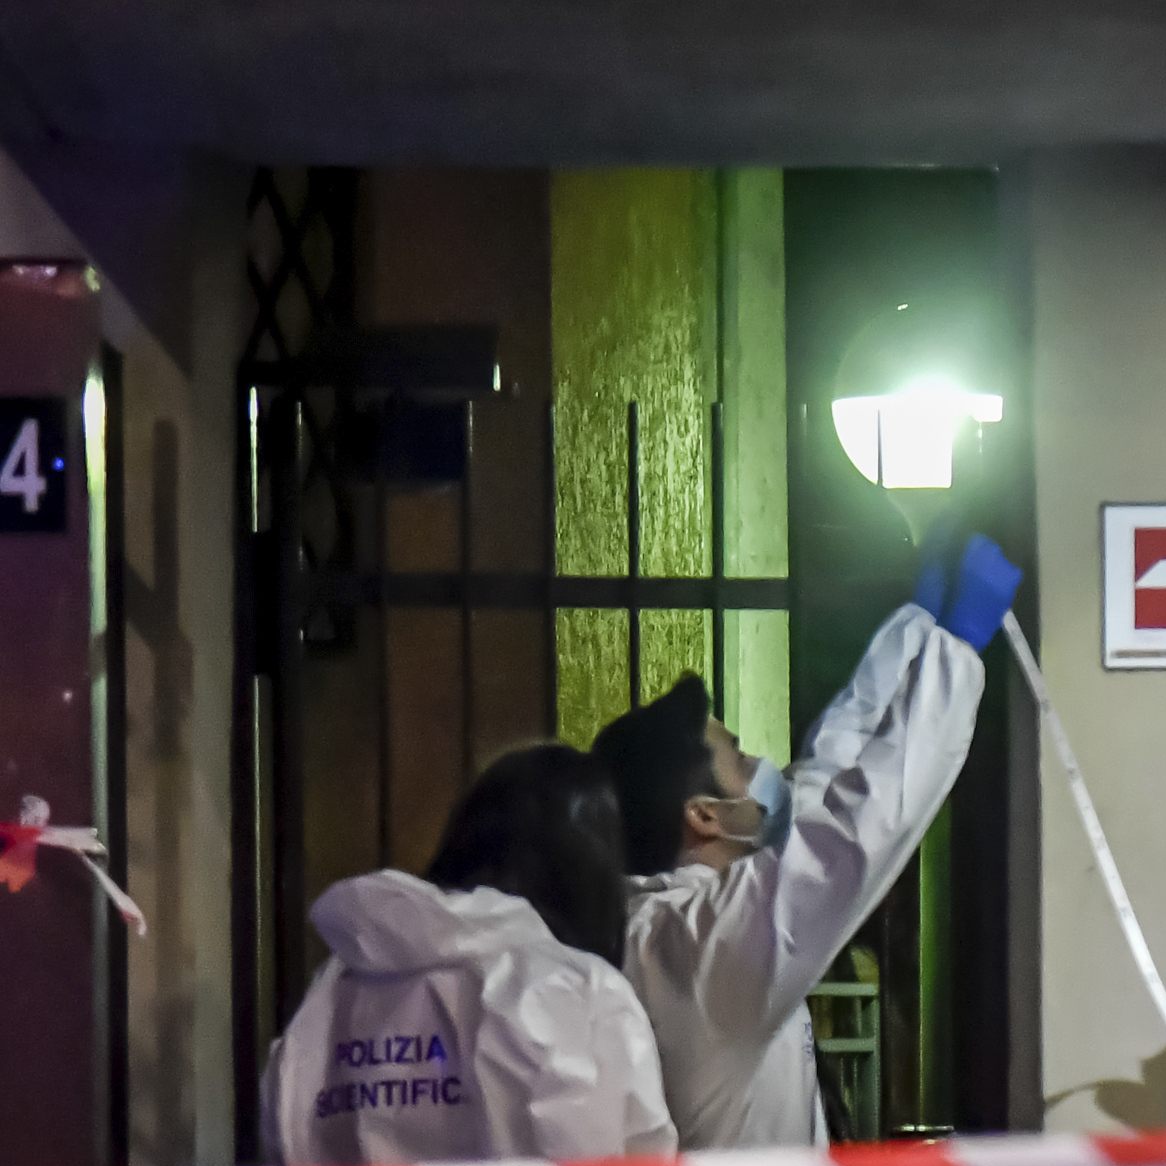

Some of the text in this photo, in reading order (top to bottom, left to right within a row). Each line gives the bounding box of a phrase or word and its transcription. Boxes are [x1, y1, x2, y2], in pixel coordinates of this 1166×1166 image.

[0, 417, 47, 514] 4
[335, 1034, 448, 1068] POLIZIA
[315, 1076, 464, 1119] SCIENTIFIC
